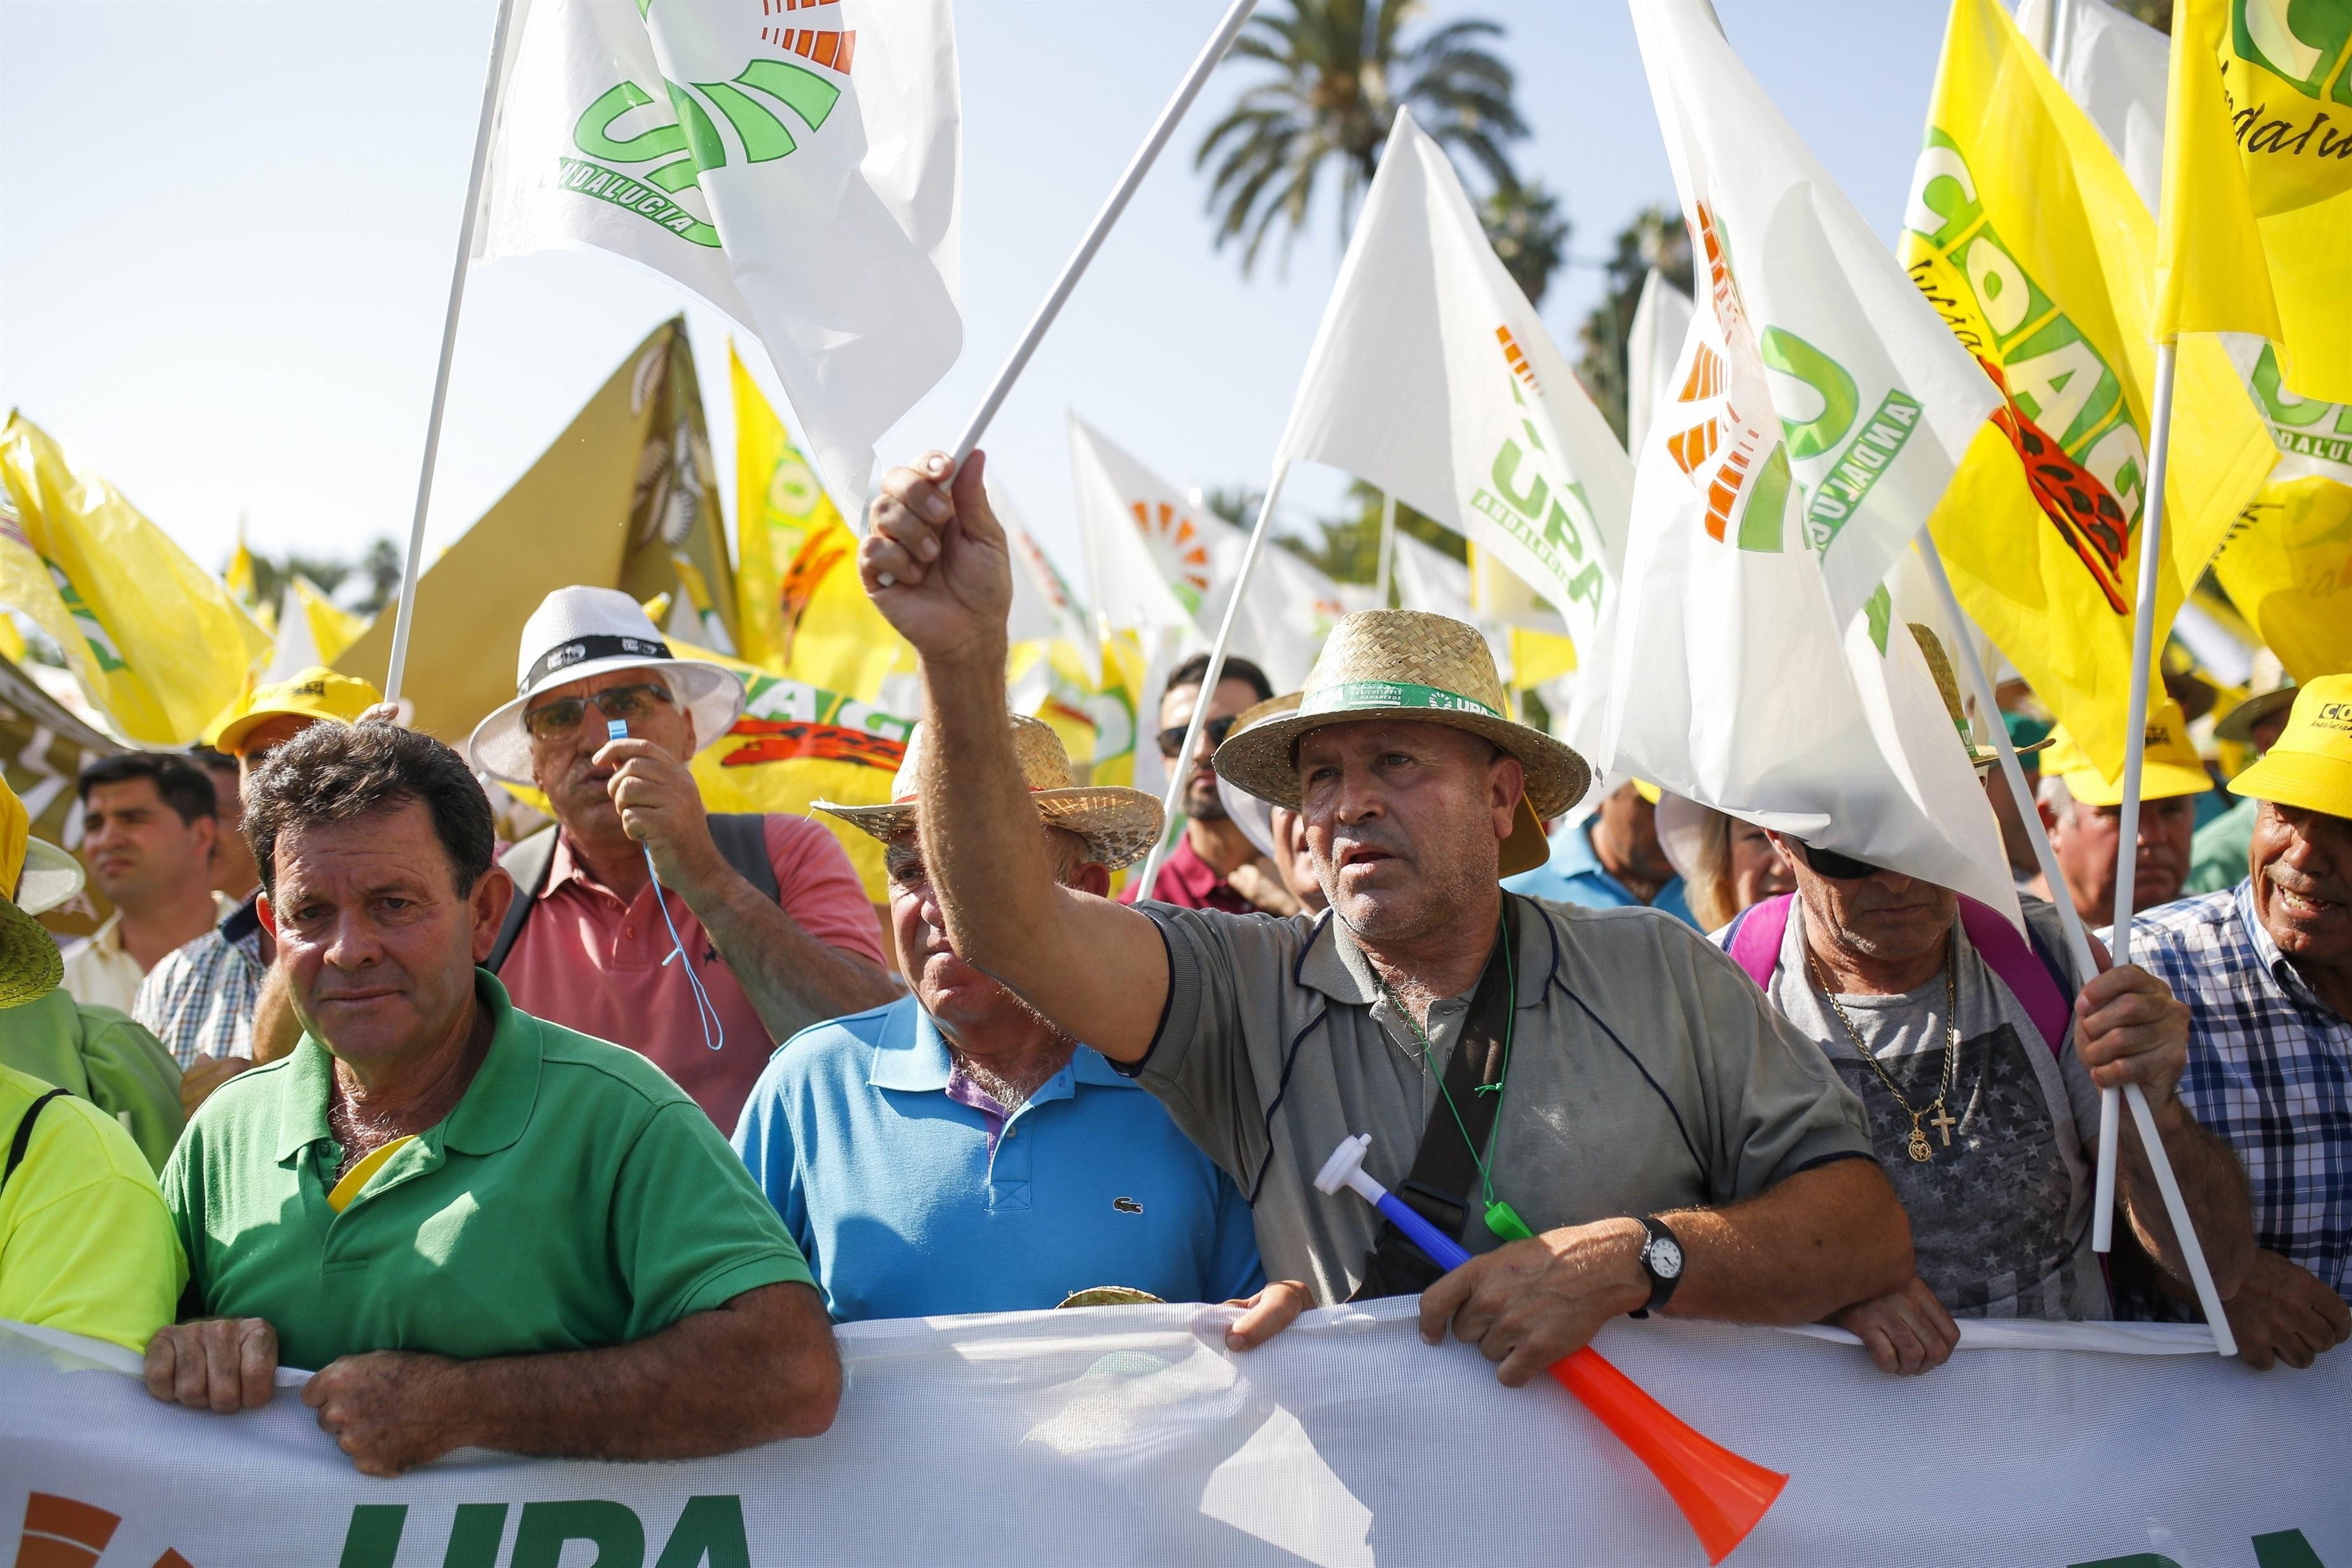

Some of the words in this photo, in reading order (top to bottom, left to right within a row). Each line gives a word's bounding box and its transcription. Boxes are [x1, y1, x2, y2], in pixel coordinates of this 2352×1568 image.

[552, 161, 695, 233] NDALUCIA
[2280, 432, 2352, 465] DALU
[1492, 437, 1603, 628] UPA
